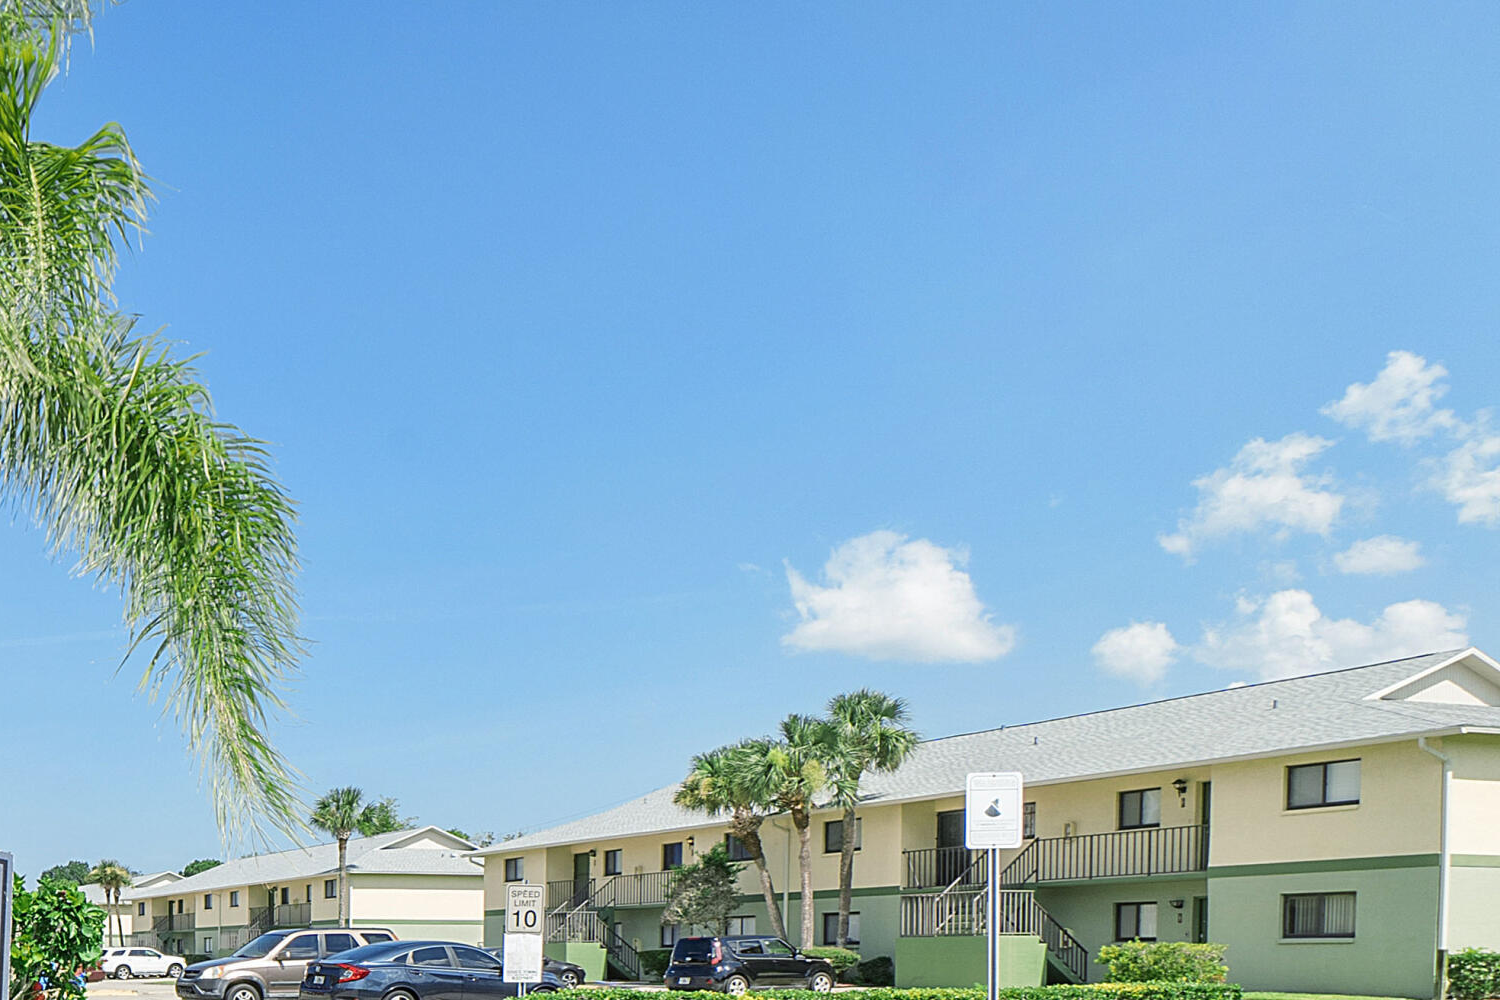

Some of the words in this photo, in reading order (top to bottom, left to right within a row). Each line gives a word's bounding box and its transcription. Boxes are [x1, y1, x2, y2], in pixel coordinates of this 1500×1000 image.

[511, 890, 541, 898] SPEED
[514, 899, 536, 907] LIMIT
[512, 909, 537, 928] 10
